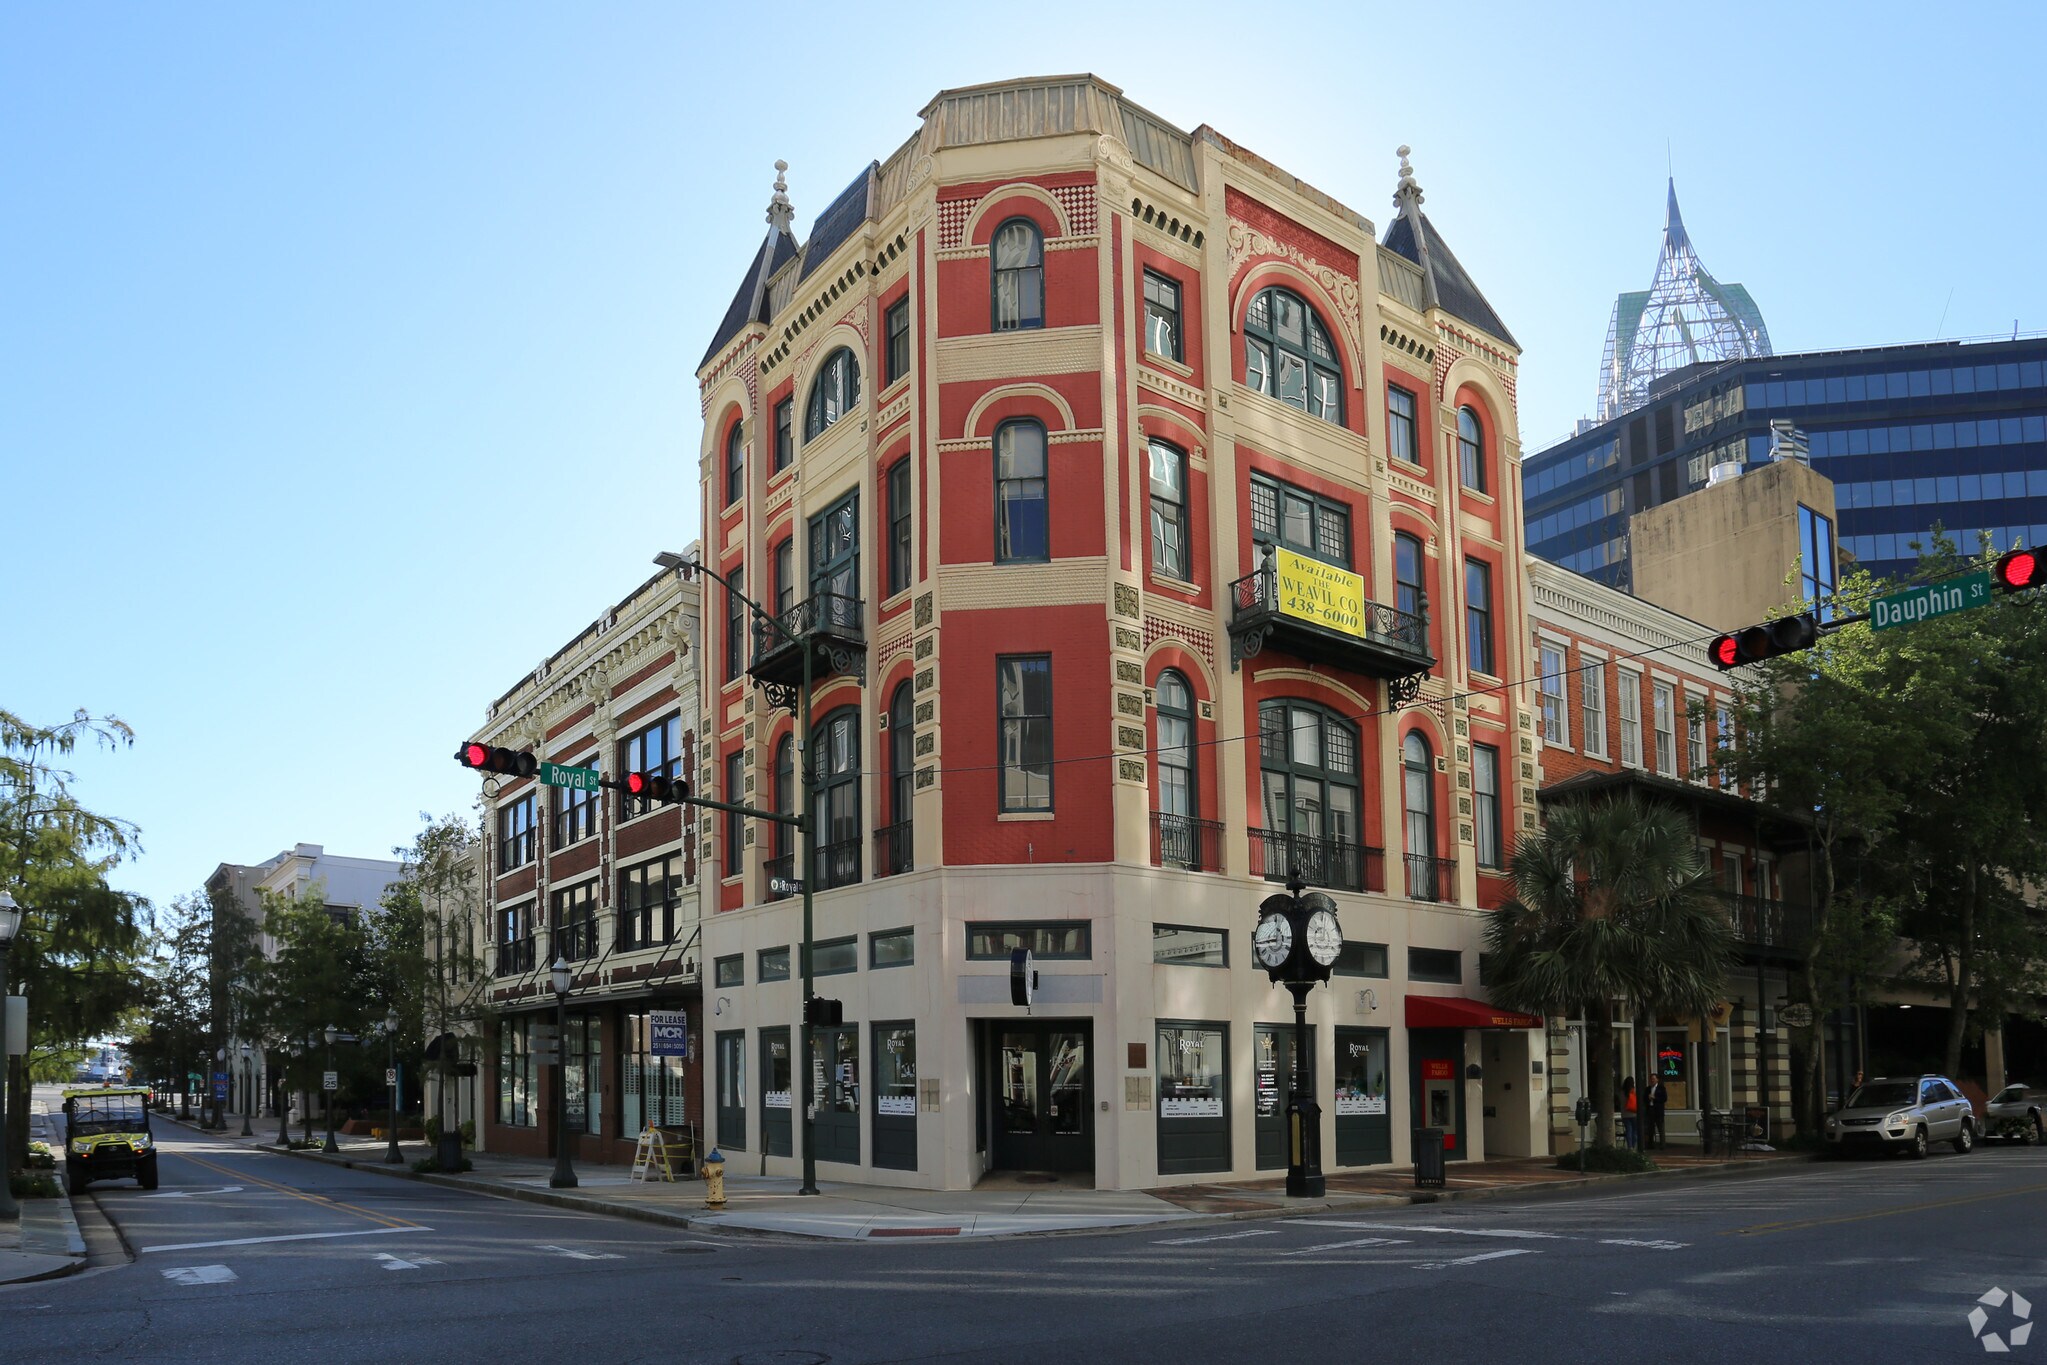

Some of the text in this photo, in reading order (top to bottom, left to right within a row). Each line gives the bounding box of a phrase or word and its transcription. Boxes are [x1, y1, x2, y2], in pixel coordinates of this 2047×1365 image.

[1290, 558, 1353, 587] Available
[1312, 577, 1331, 590] THE
[1282, 576, 1361, 615] WEAVIL CO.
[1287, 597, 1358, 628] 438-6000
[1876, 583, 1984, 627] Dauphin St
[551, 766, 597, 789] Royal St
[781, 880, 798, 894] Royal
[650, 1015, 686, 1024] FOR LEASE
[1492, 1016, 1532, 1026] WELLS FARGO
[654, 1026, 683, 1039] MCR
